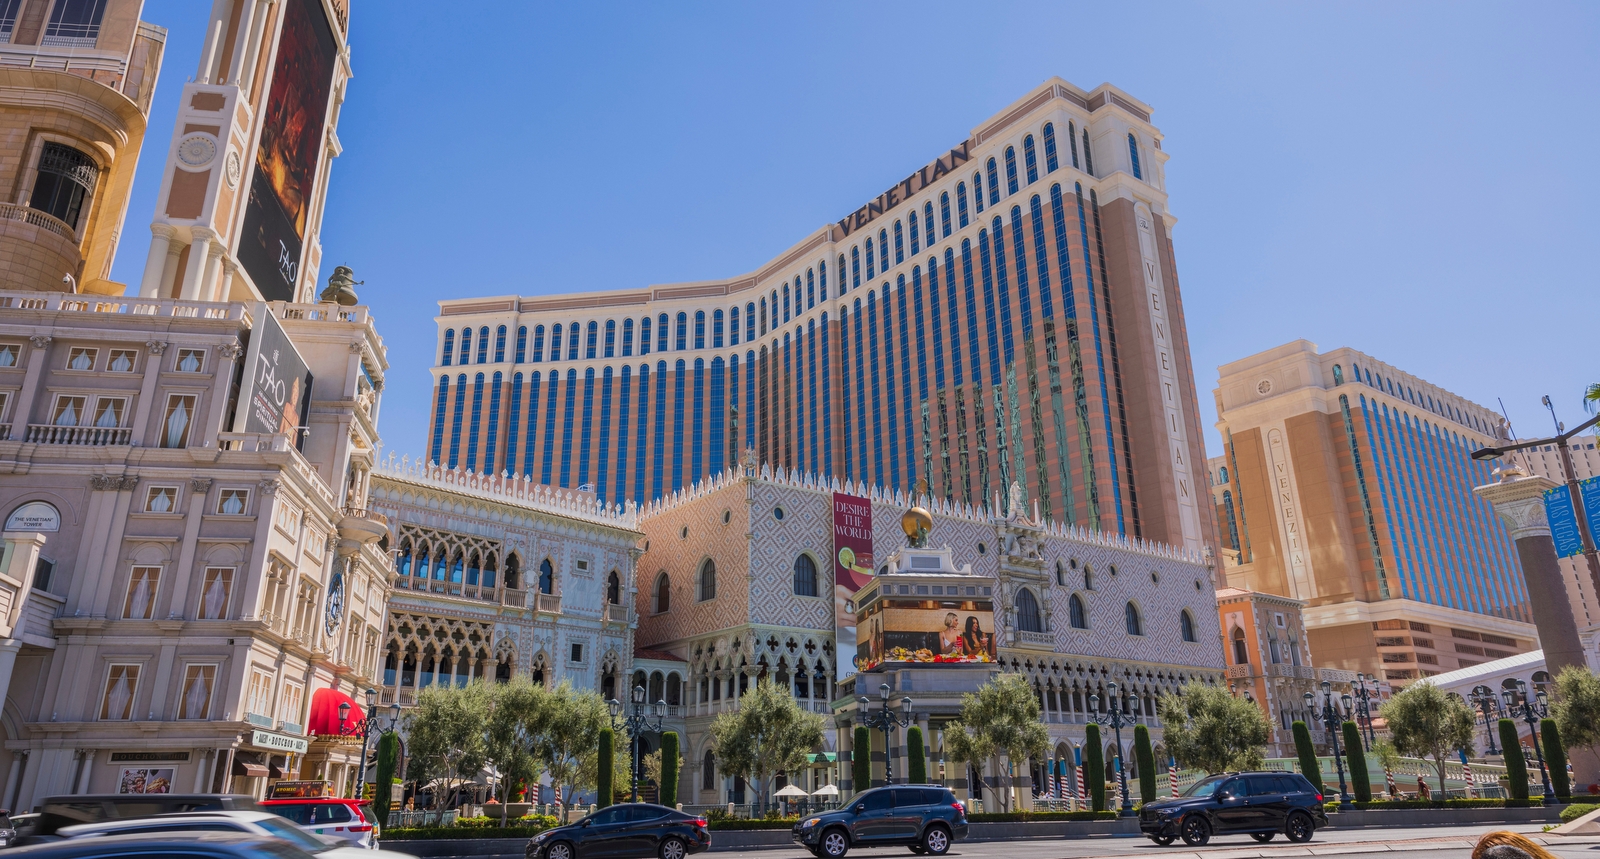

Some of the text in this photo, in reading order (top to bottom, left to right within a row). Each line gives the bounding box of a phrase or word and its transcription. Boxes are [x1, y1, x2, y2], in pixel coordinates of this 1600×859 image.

[837, 140, 969, 237] VENETIAN
[279, 239, 297, 282] TAO
[259, 353, 286, 407] TAO
[1146, 262, 1189, 498] VENETIAN
[253, 396, 279, 430] SPIRITUAL
[255, 409, 274, 434] DINING
[836, 501, 870, 518] DESIRE
[842, 513, 864, 528] THE
[1277, 463, 1302, 565] VENEZIA
[1549, 499, 1578, 551] LAS VEGAS
[835, 524, 872, 541] WORLD
[271, 736, 294, 748] BOUCHON
